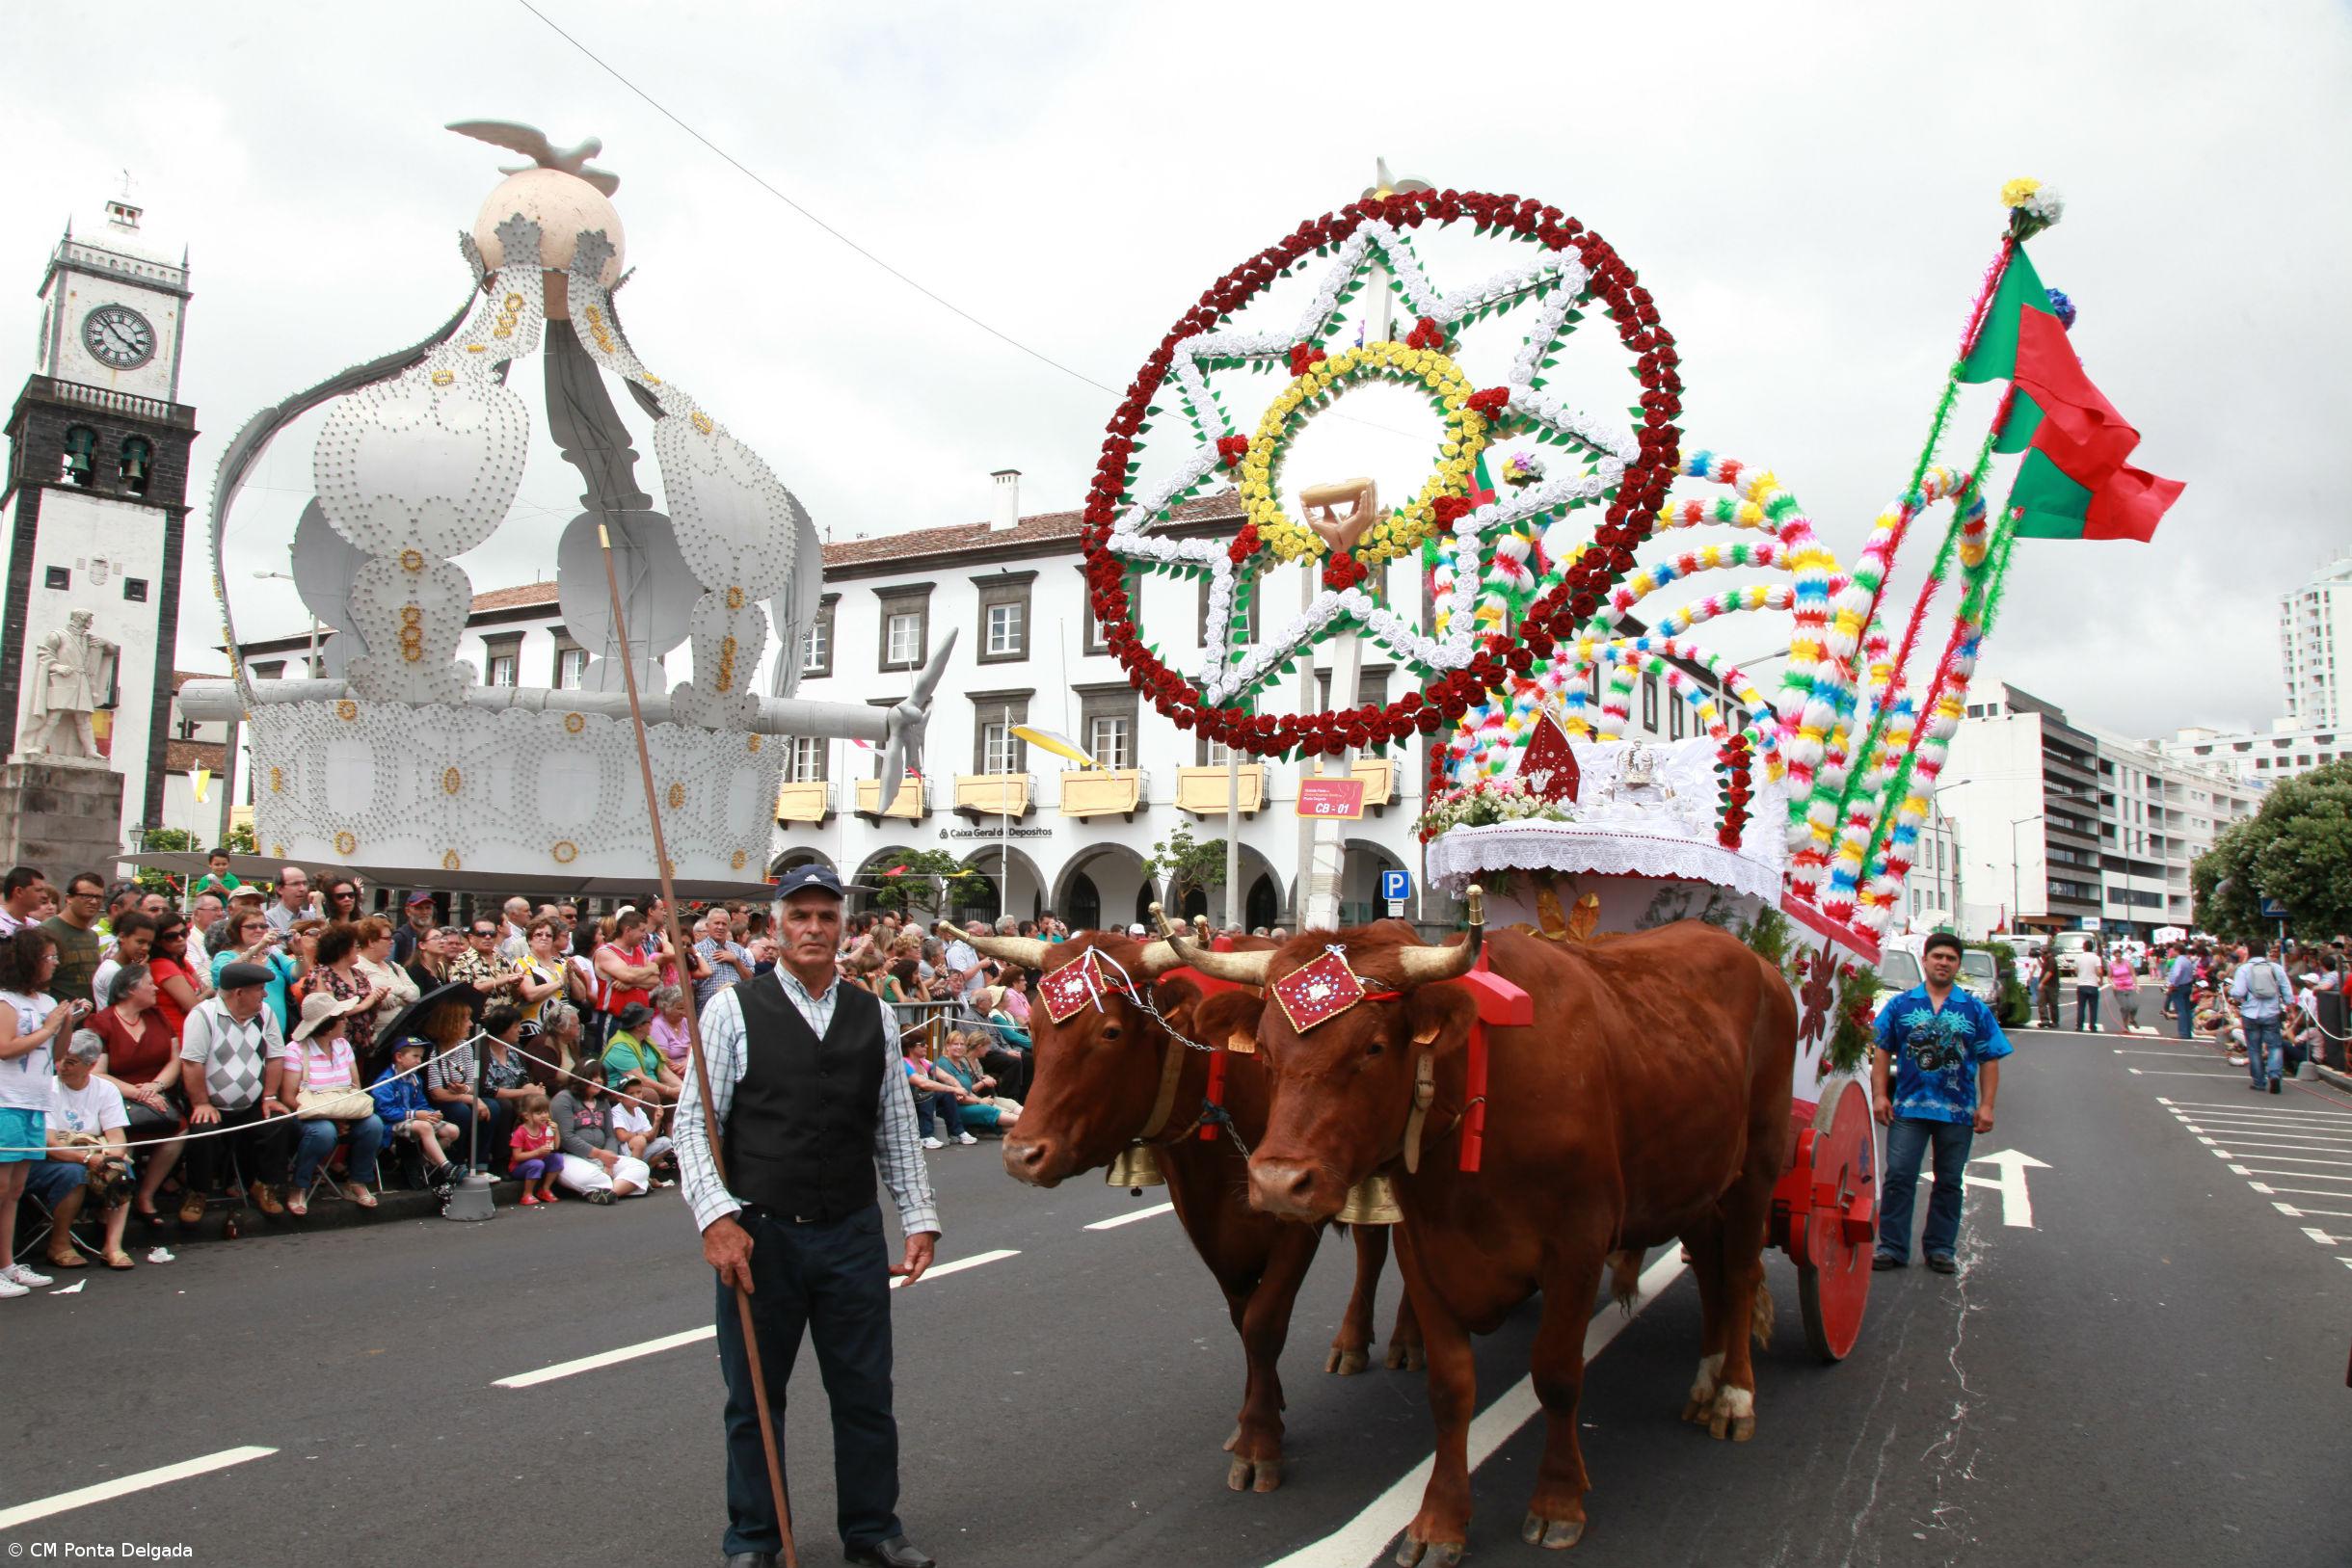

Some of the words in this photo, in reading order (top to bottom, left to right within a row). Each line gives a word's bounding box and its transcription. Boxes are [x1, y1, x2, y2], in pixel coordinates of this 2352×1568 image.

[1316, 803, 1330, 813] CB
[1337, 804, 1350, 814] 01
[950, 828, 973, 837] Caixa
[974, 828, 996, 837] Geral
[1008, 827, 1053, 837] Depositos
[1388, 873, 1403, 897] P
